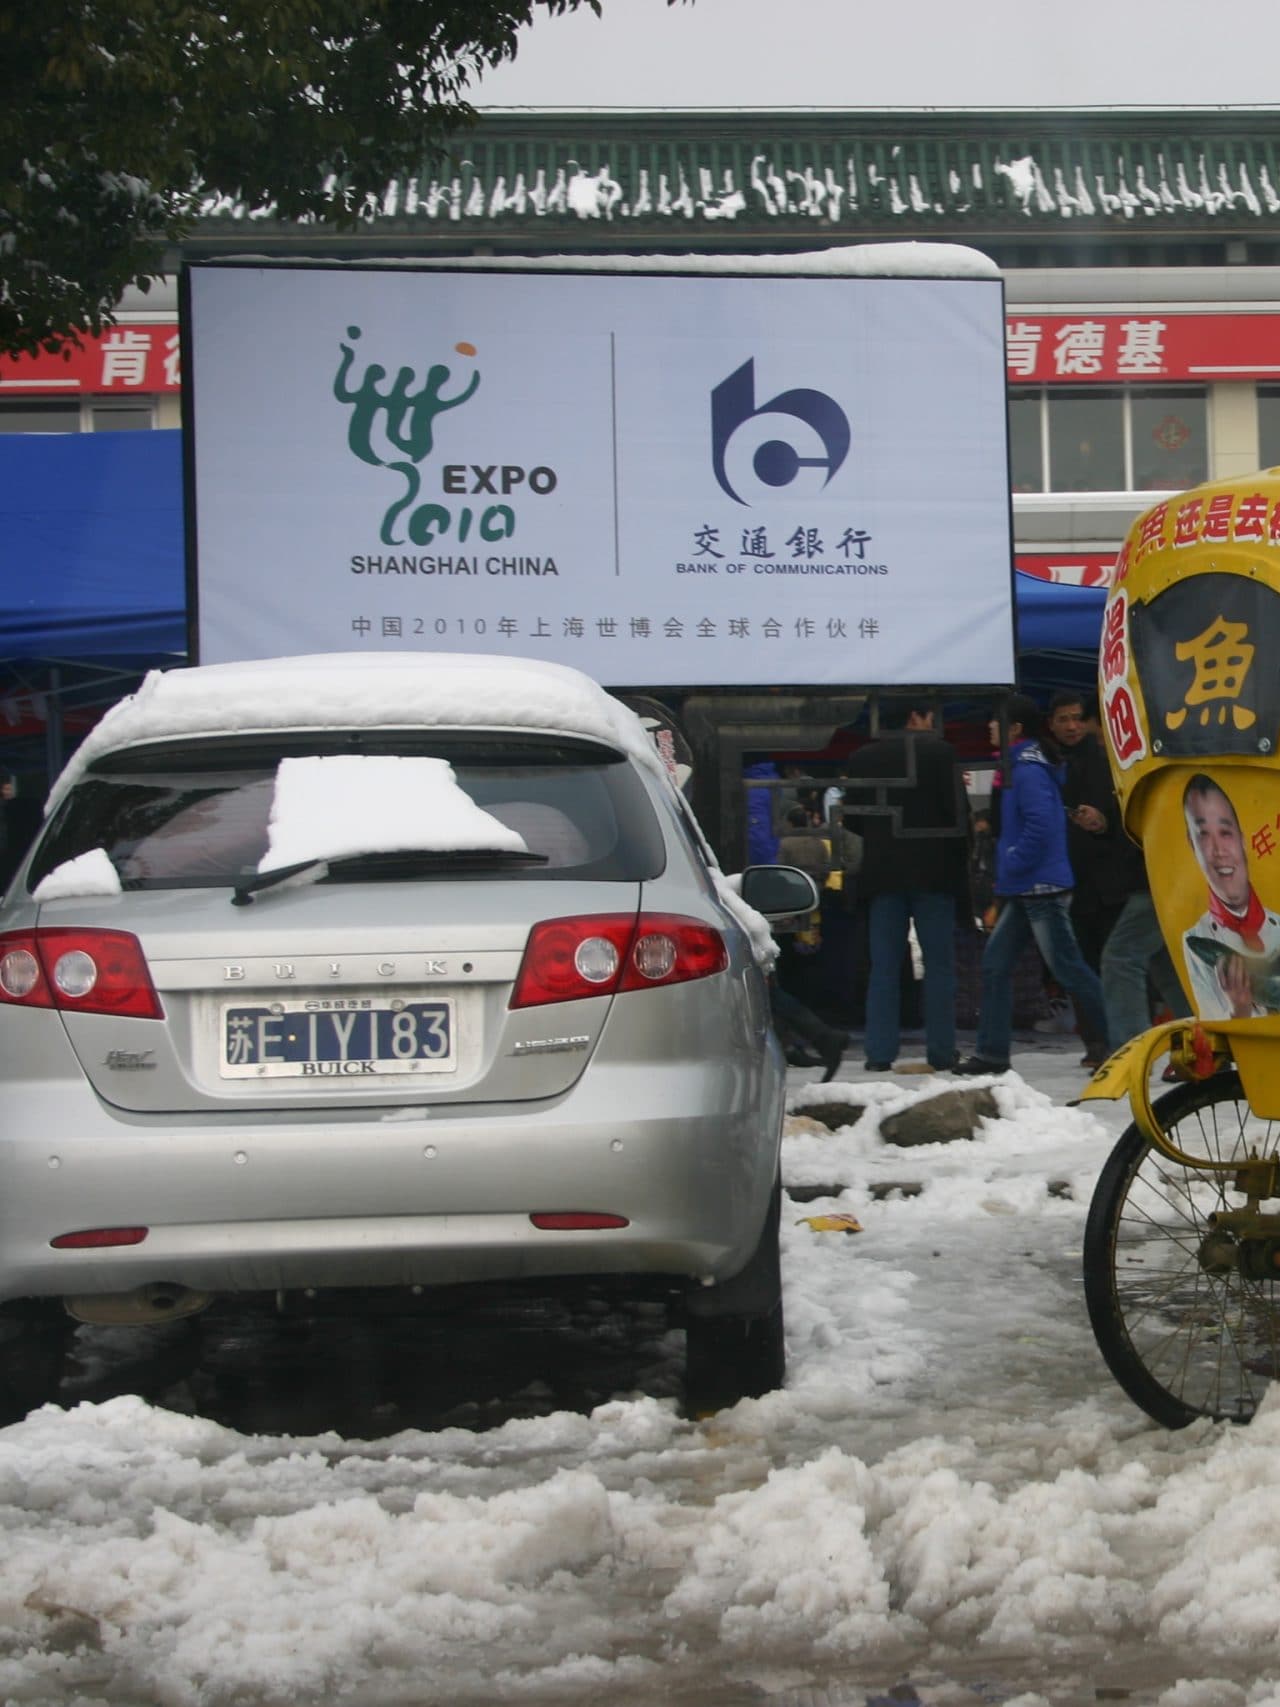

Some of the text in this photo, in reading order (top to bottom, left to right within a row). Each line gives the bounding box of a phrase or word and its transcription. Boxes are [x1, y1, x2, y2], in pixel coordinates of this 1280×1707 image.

[101, 331, 180, 385] 肯
[1006, 320, 1167, 375] 肯德基
[442, 465, 557, 495] EXPO
[692, 523, 873, 560] 交通銀行
[351, 555, 559, 577] SHANGHAI CHINA
[676, 563, 889, 576] BANK OF COMMUNICATIONS
[223, 960, 448, 980] BUICK
[302, 1061, 377, 1076] BUICK
